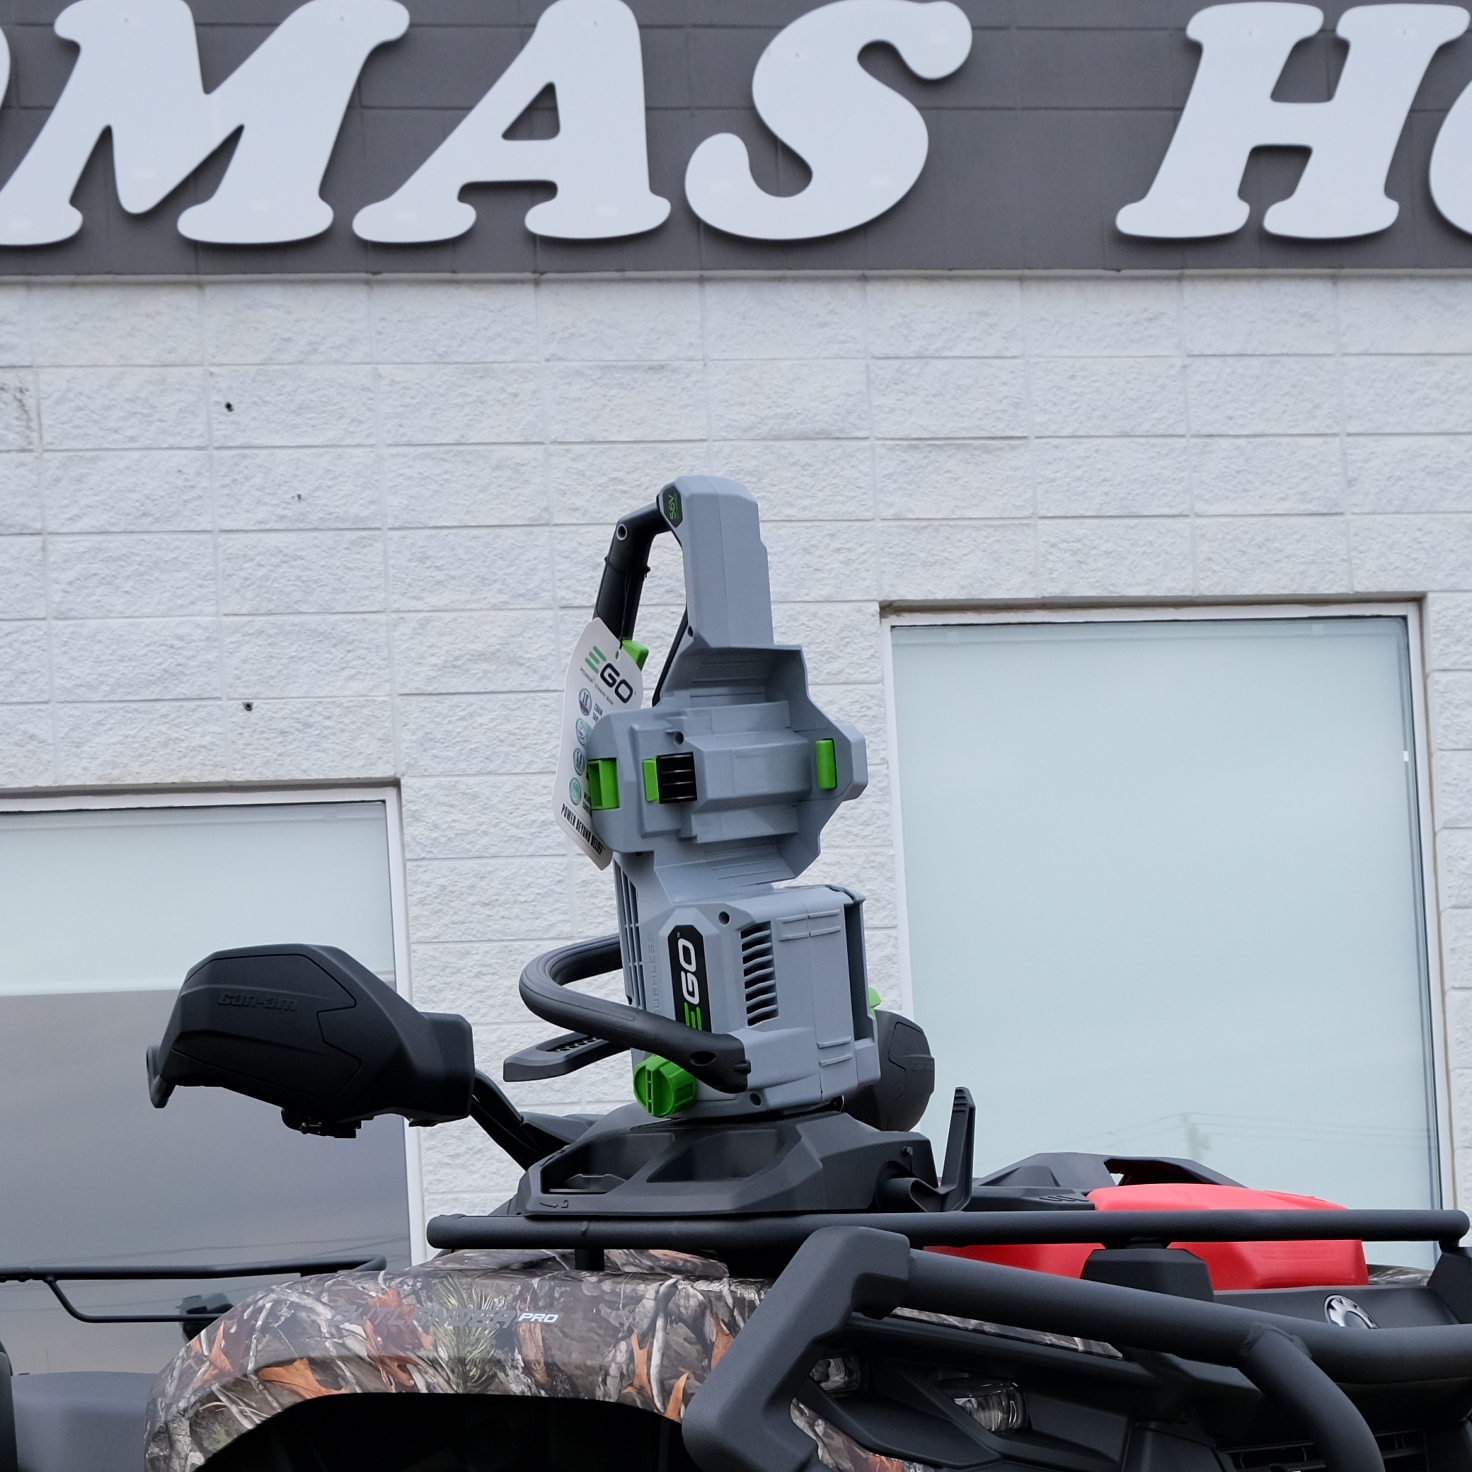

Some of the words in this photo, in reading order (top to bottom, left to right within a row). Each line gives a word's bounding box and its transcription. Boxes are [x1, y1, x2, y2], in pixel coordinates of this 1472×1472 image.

[585, 645, 634, 704] EGO
[561, 803, 577, 827] POWER
[677, 938, 703, 1031] EGO
[329, 1304, 519, 1330] OUTLANDER
[518, 1312, 560, 1325] PRO
